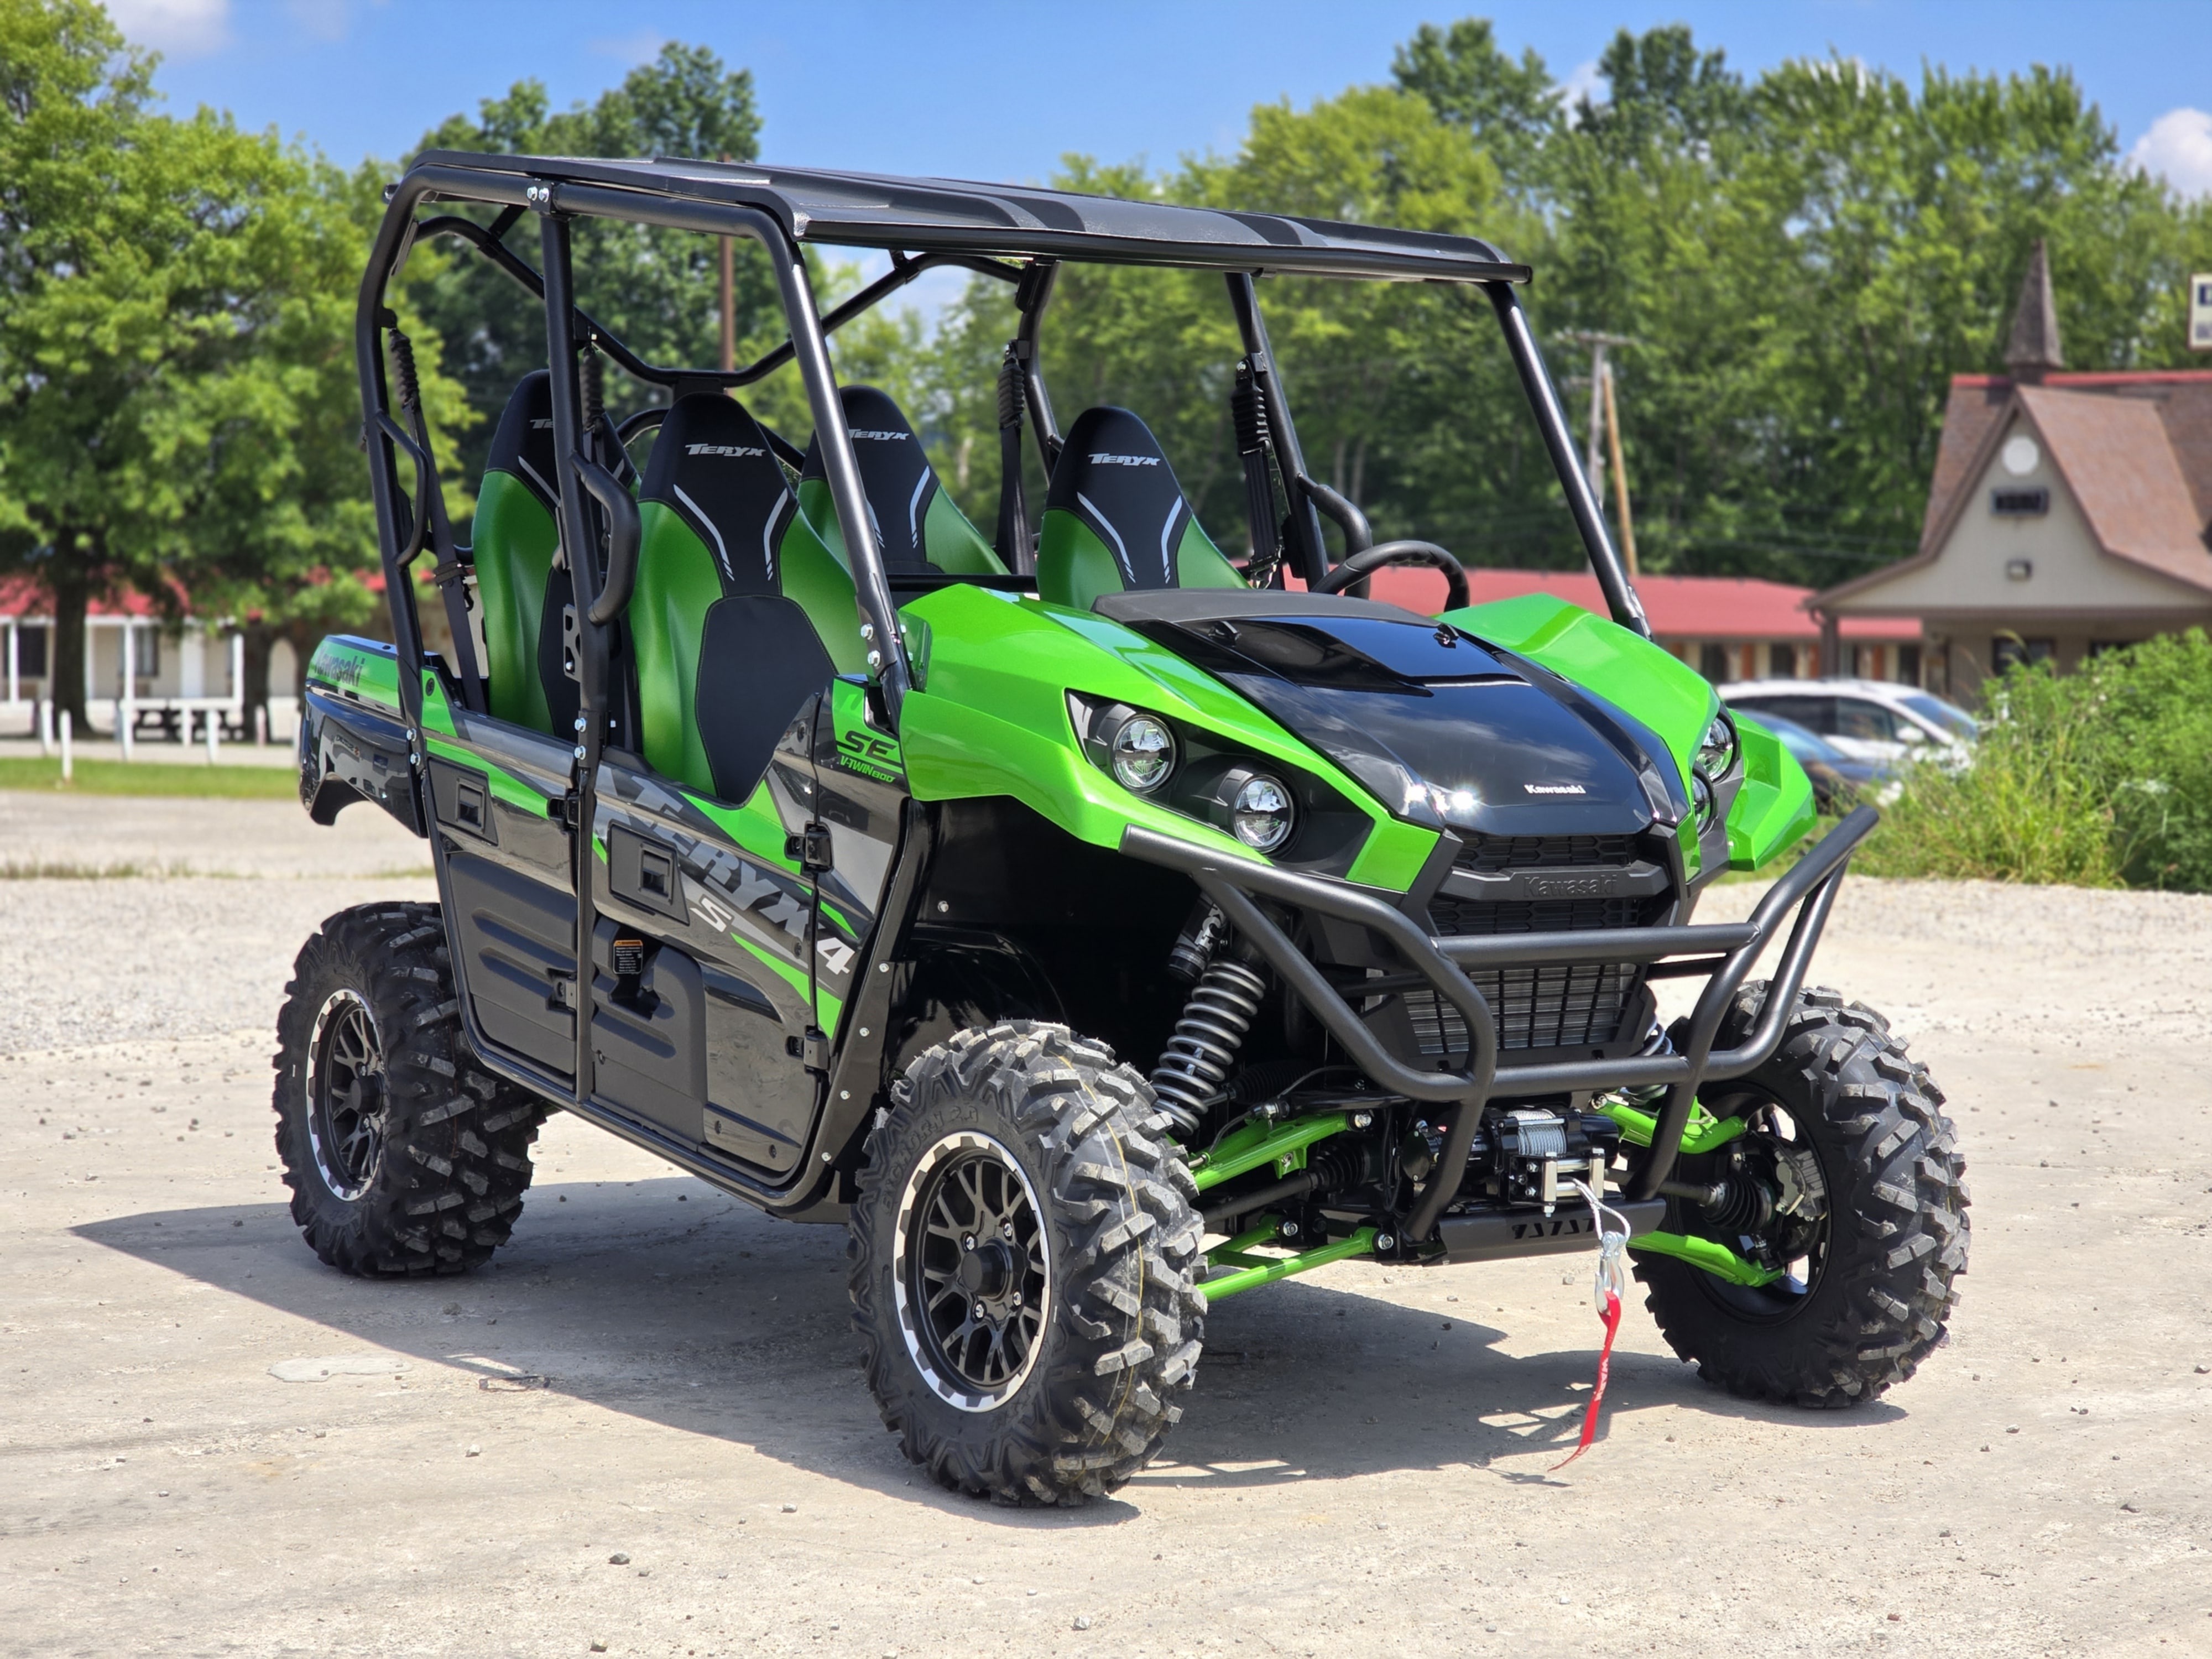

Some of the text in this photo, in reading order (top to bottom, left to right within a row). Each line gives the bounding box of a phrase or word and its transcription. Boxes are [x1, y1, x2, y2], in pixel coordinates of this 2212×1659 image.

[685, 443, 766, 457] TERYX
[1088, 453, 1161, 466] TERYX
[314, 645, 366, 687] Kawasaki
[838, 730, 900, 764] SE
[1524, 784, 1587, 794] Kawasaki
[1523, 874, 1618, 899] Kawasaki
[816, 937, 855, 975] 4
